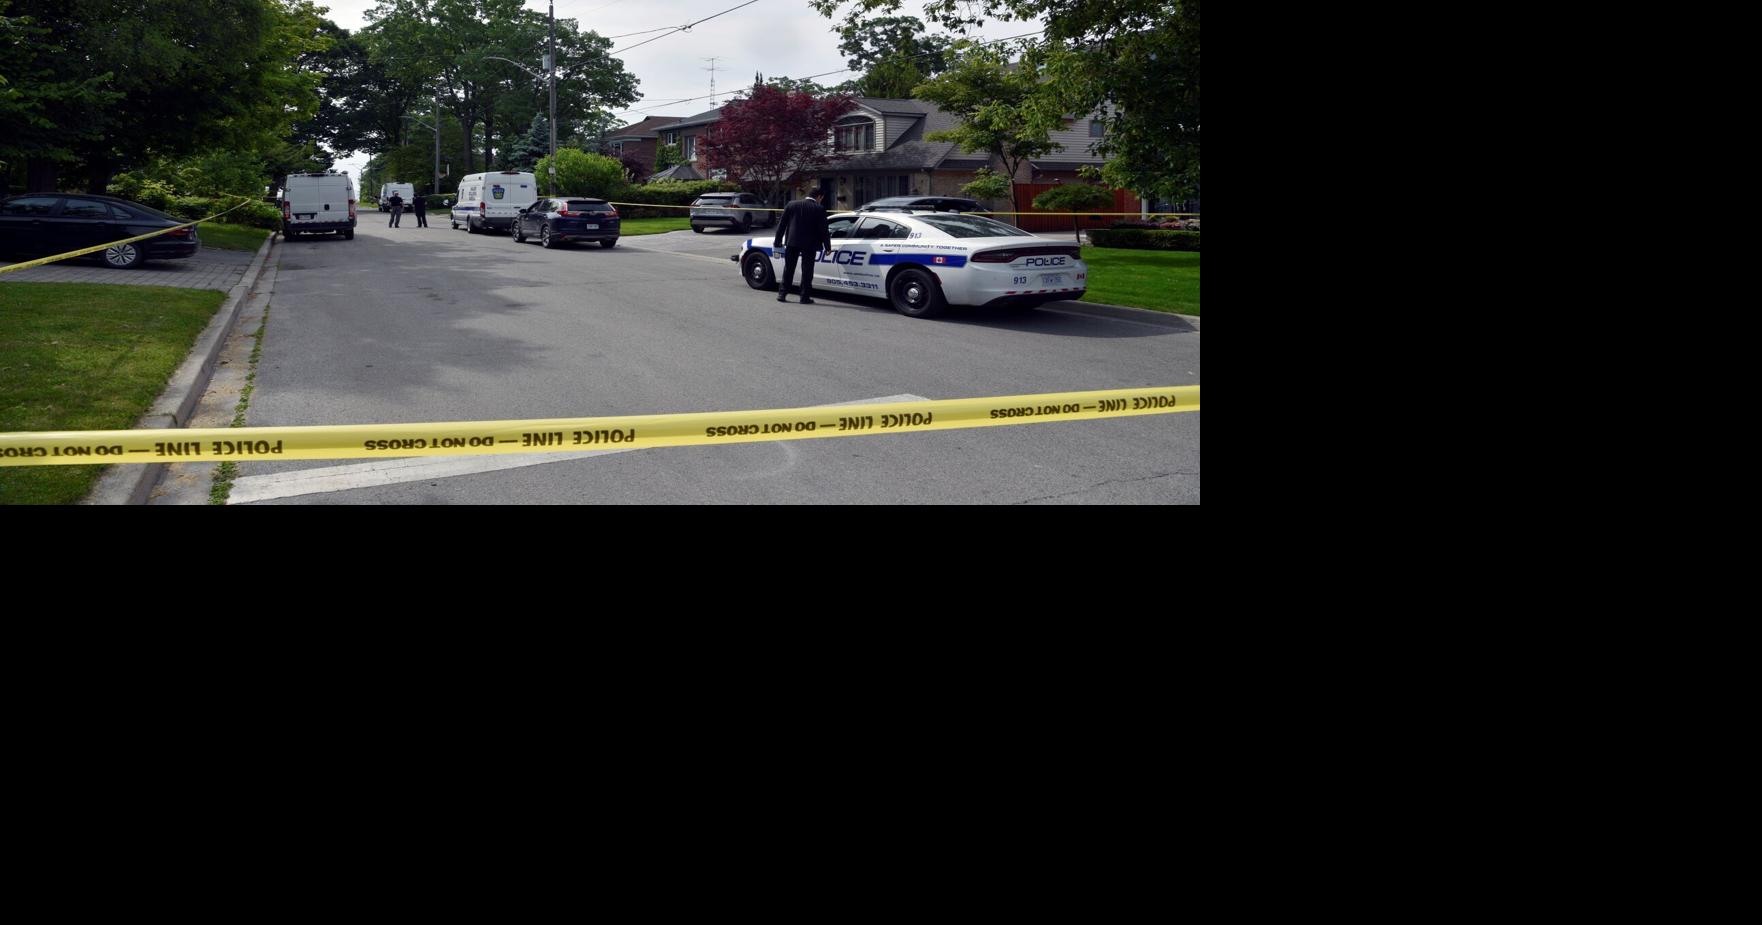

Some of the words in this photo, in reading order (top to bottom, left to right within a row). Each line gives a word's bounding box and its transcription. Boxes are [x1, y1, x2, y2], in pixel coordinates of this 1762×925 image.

[815, 249, 867, 266] LICE
[1026, 257, 1065, 266] POLICE
[1013, 276, 1027, 284] 913
[1098, 399, 1127, 412] LINE
[1132, 395, 1176, 409] POLICE
[989, 407, 1035, 418] CROSS
[1034, 405, 1061, 415] NOT
[1062, 404, 1080, 413] DO
[838, 416, 874, 430] LINE
[880, 412, 933, 427] POLICE
[705, 425, 760, 436] CROSS
[761, 423, 793, 433] NOT
[794, 421, 817, 431] DO
[468, 437, 495, 446] DO
[522, 432, 563, 446] LINE
[572, 429, 636, 444] POLICE
[154, 442, 201, 455] LINE
[211, 440, 283, 454] POLICE
[363, 439, 428, 450] CROSS
[429, 438, 466, 448] NOT
[51, 446, 92, 456] NOT
[94, 445, 124, 455] DO
